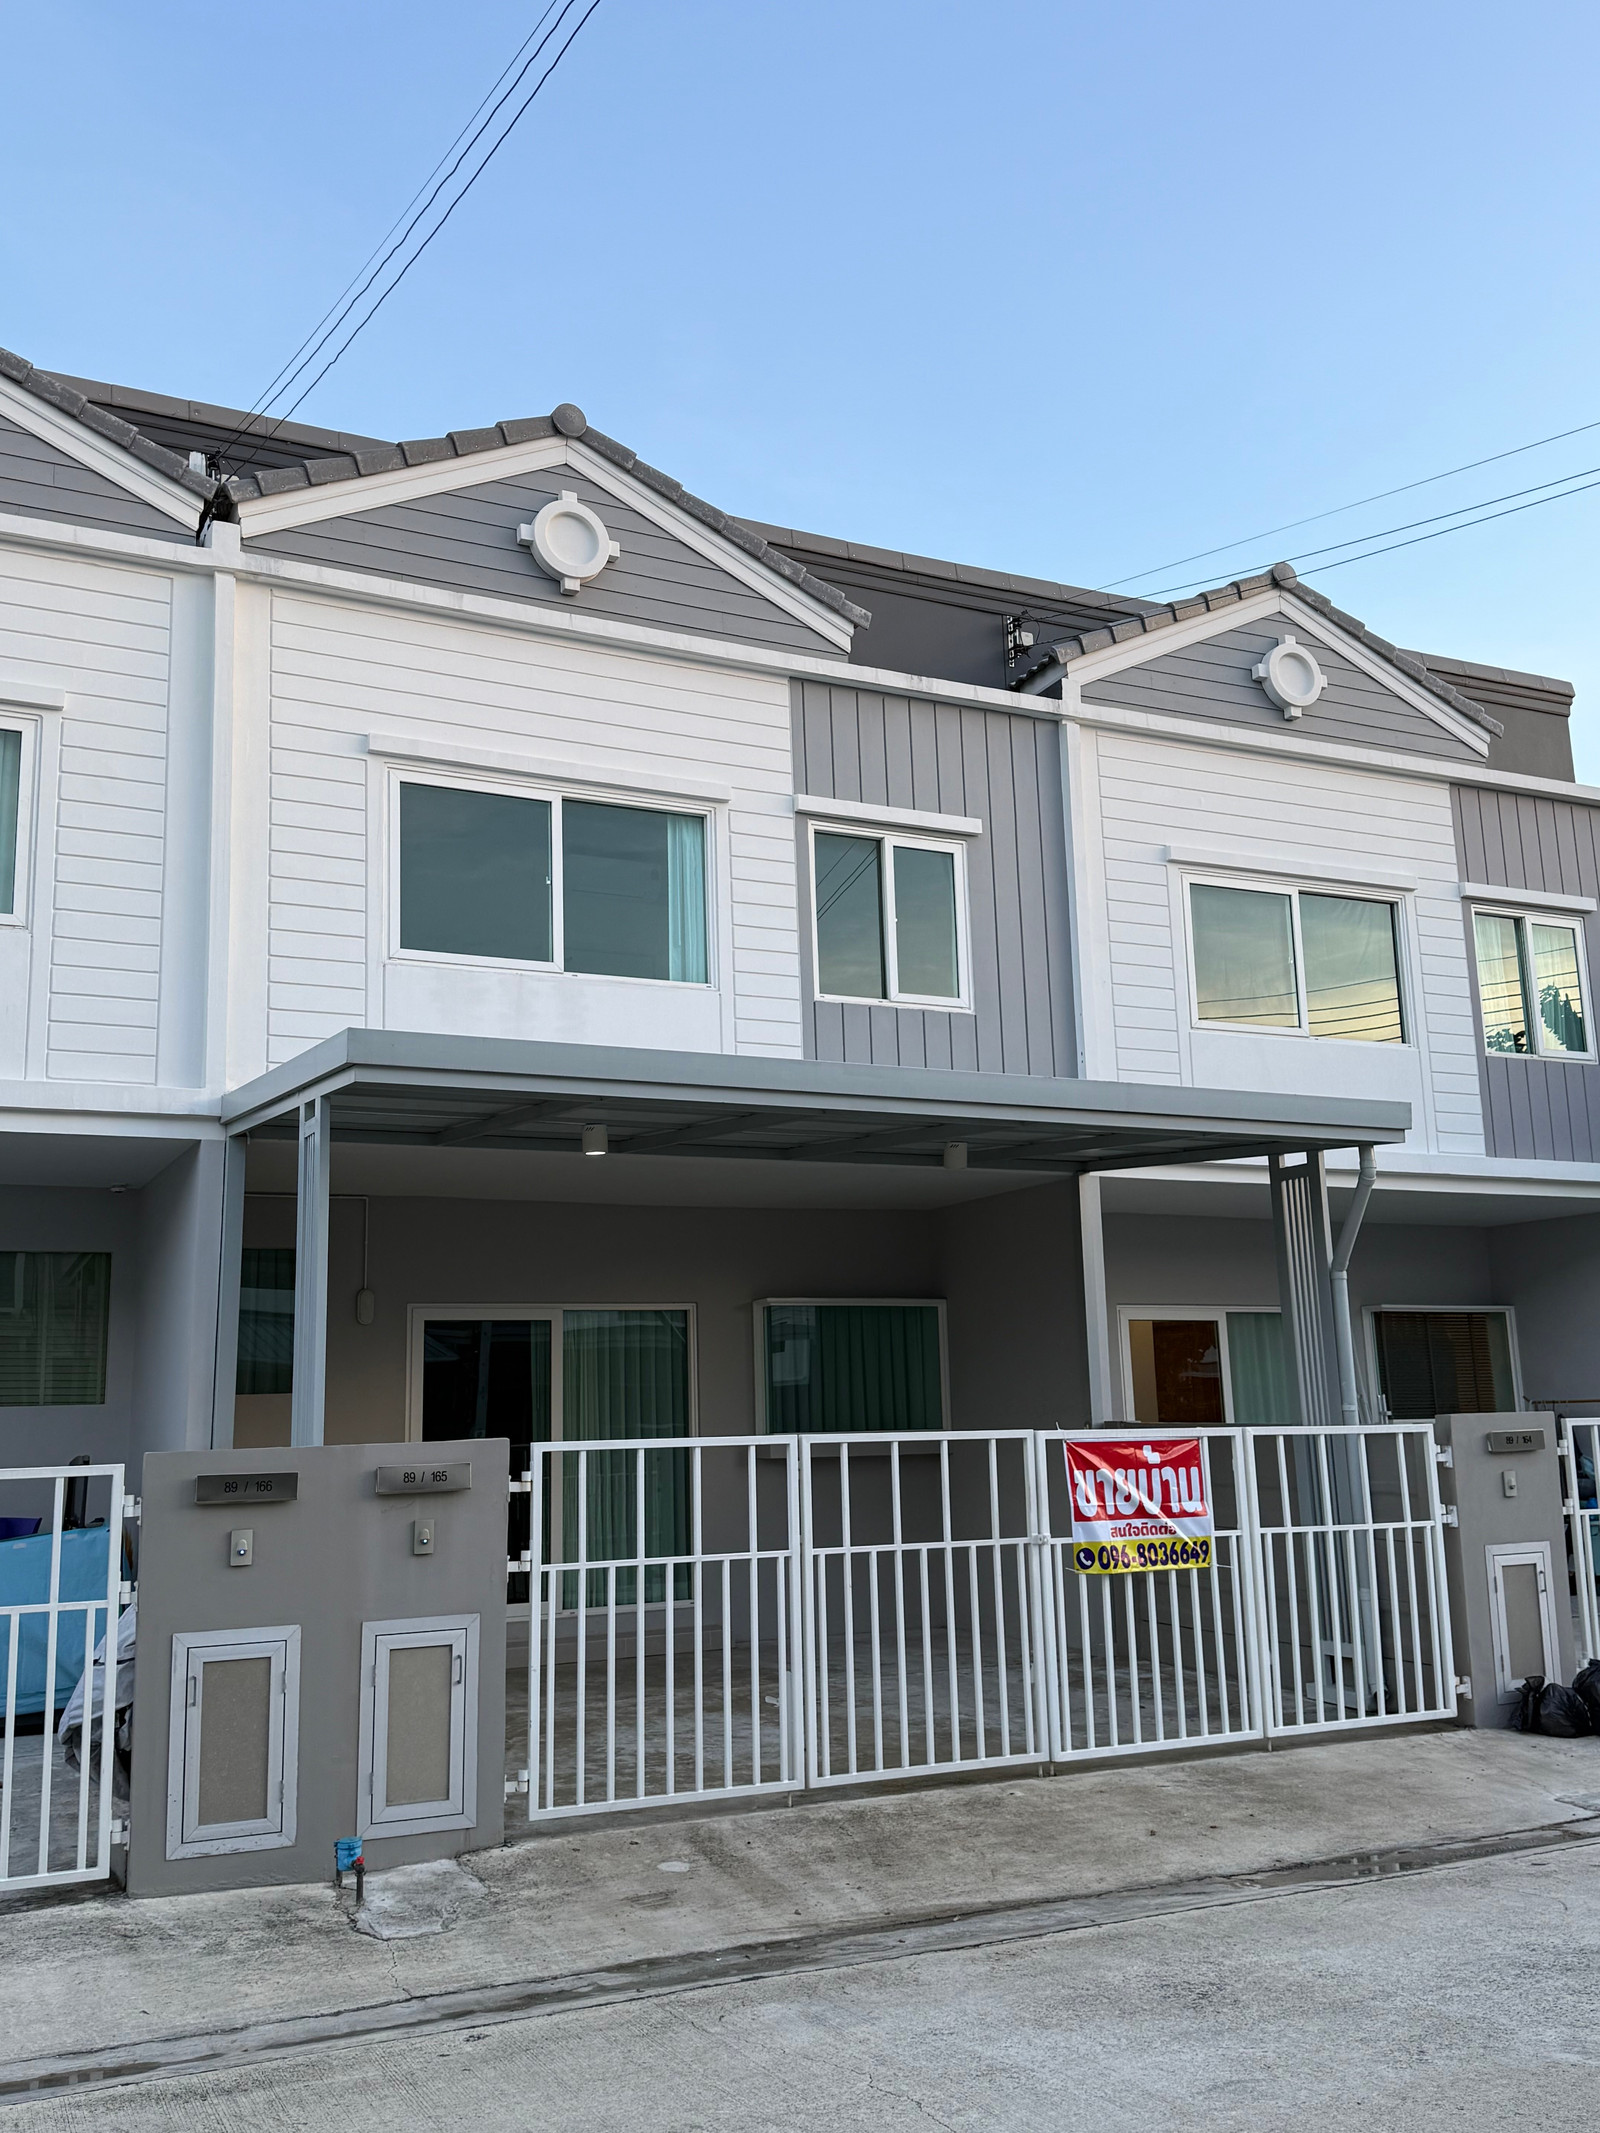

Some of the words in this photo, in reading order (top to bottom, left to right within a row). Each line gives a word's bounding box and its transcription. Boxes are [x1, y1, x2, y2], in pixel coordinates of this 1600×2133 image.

[403, 1472, 416, 1483] 89
[430, 1471, 448, 1482] 165
[1073, 1445, 1203, 1517] ขายบ้าน
[224, 1481, 238, 1493] 89
[255, 1480, 273, 1492] 166
[1110, 1522, 1178, 1538] สนใจติดต่อ
[1097, 1540, 1210, 1570] 096-8036649
